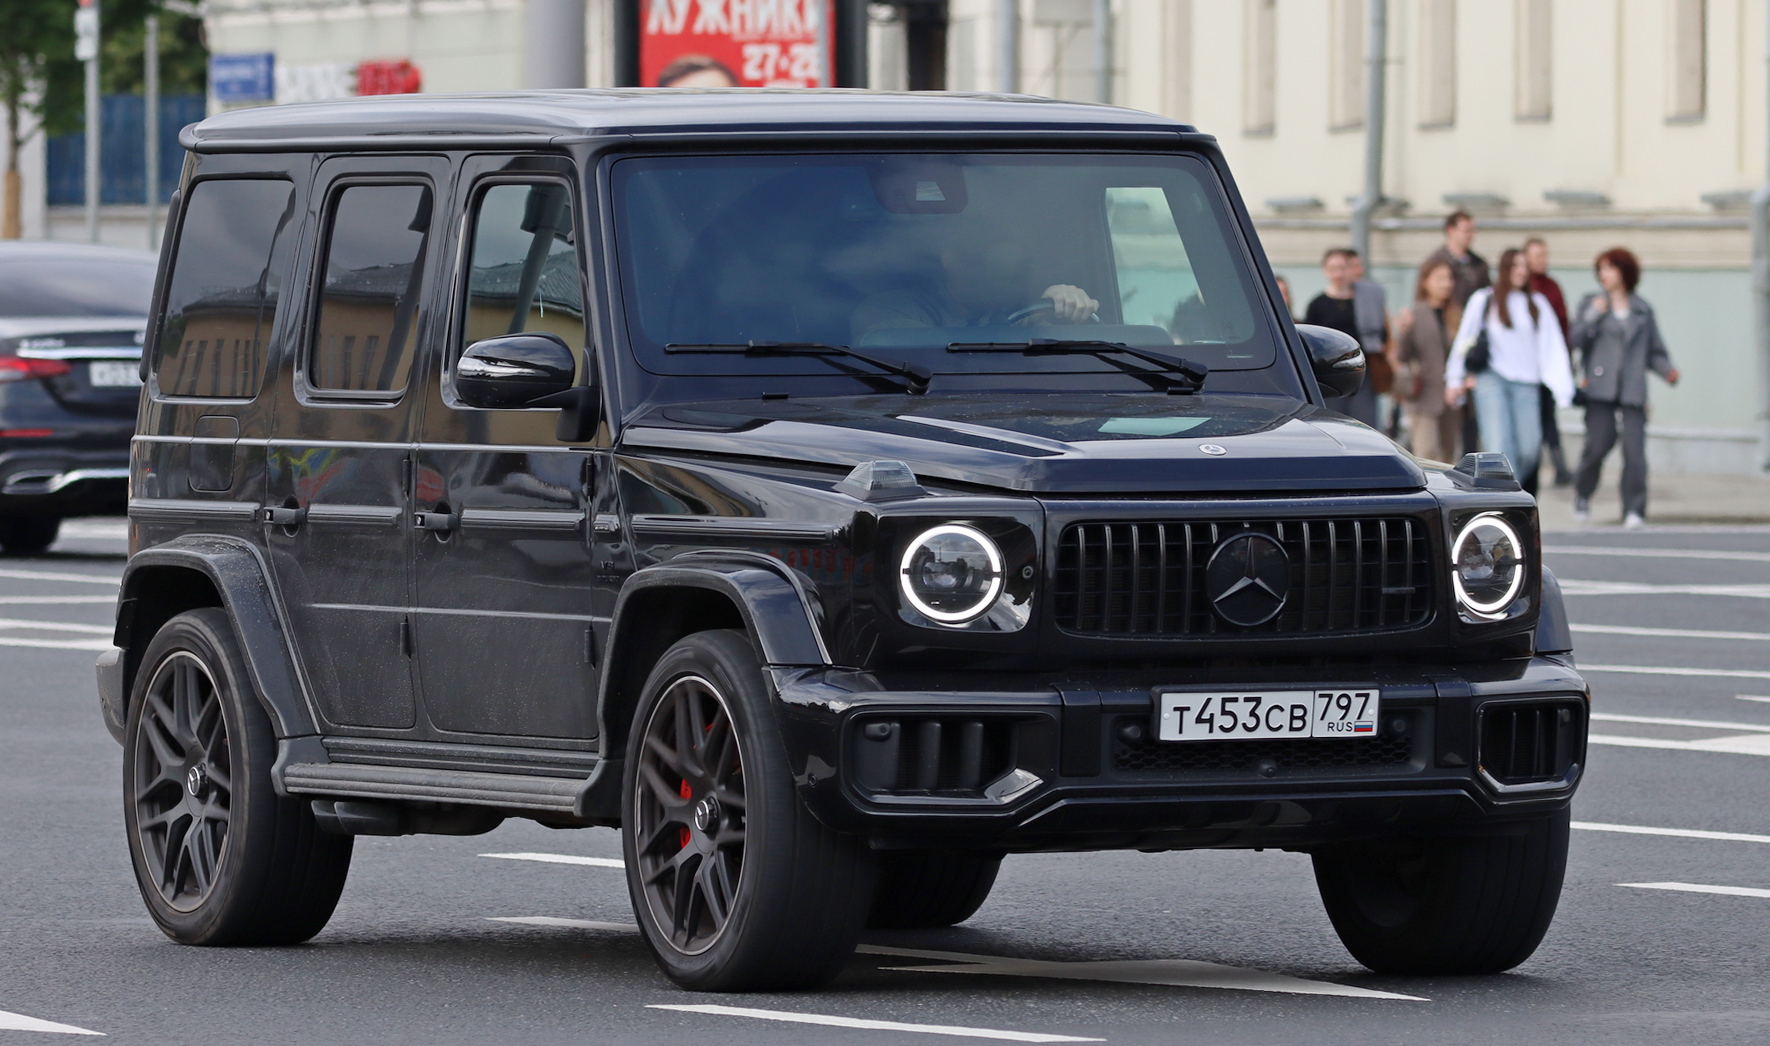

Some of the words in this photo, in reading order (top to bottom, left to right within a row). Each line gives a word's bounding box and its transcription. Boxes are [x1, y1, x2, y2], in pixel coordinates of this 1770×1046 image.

[1172, 696, 1308, 735] Т453СВ
[1318, 692, 1371, 721] 797
[1327, 721, 1354, 732] RUS
